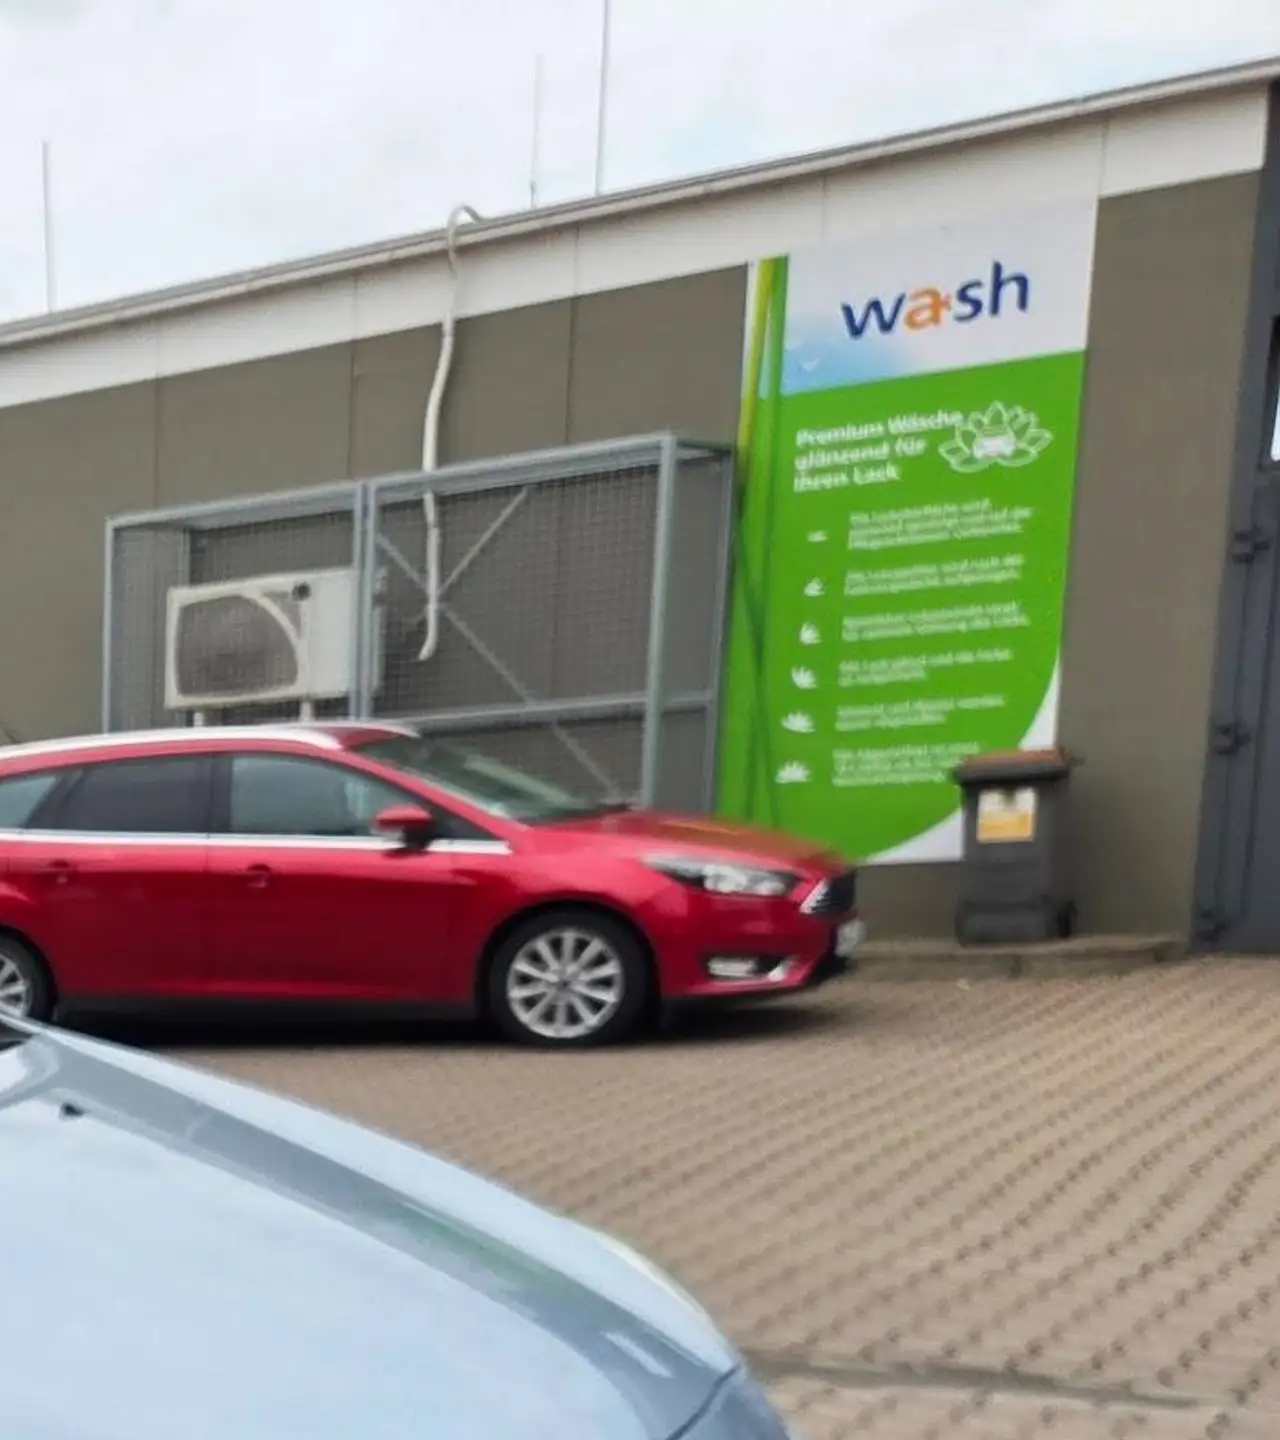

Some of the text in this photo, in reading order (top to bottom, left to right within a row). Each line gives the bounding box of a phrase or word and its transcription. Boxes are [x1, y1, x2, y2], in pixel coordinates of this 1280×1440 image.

[841, 260, 1029, 340] wash
[796, 422, 884, 446] Premium
[894, 437, 927, 457] für
[853, 462, 901, 485] Lack
